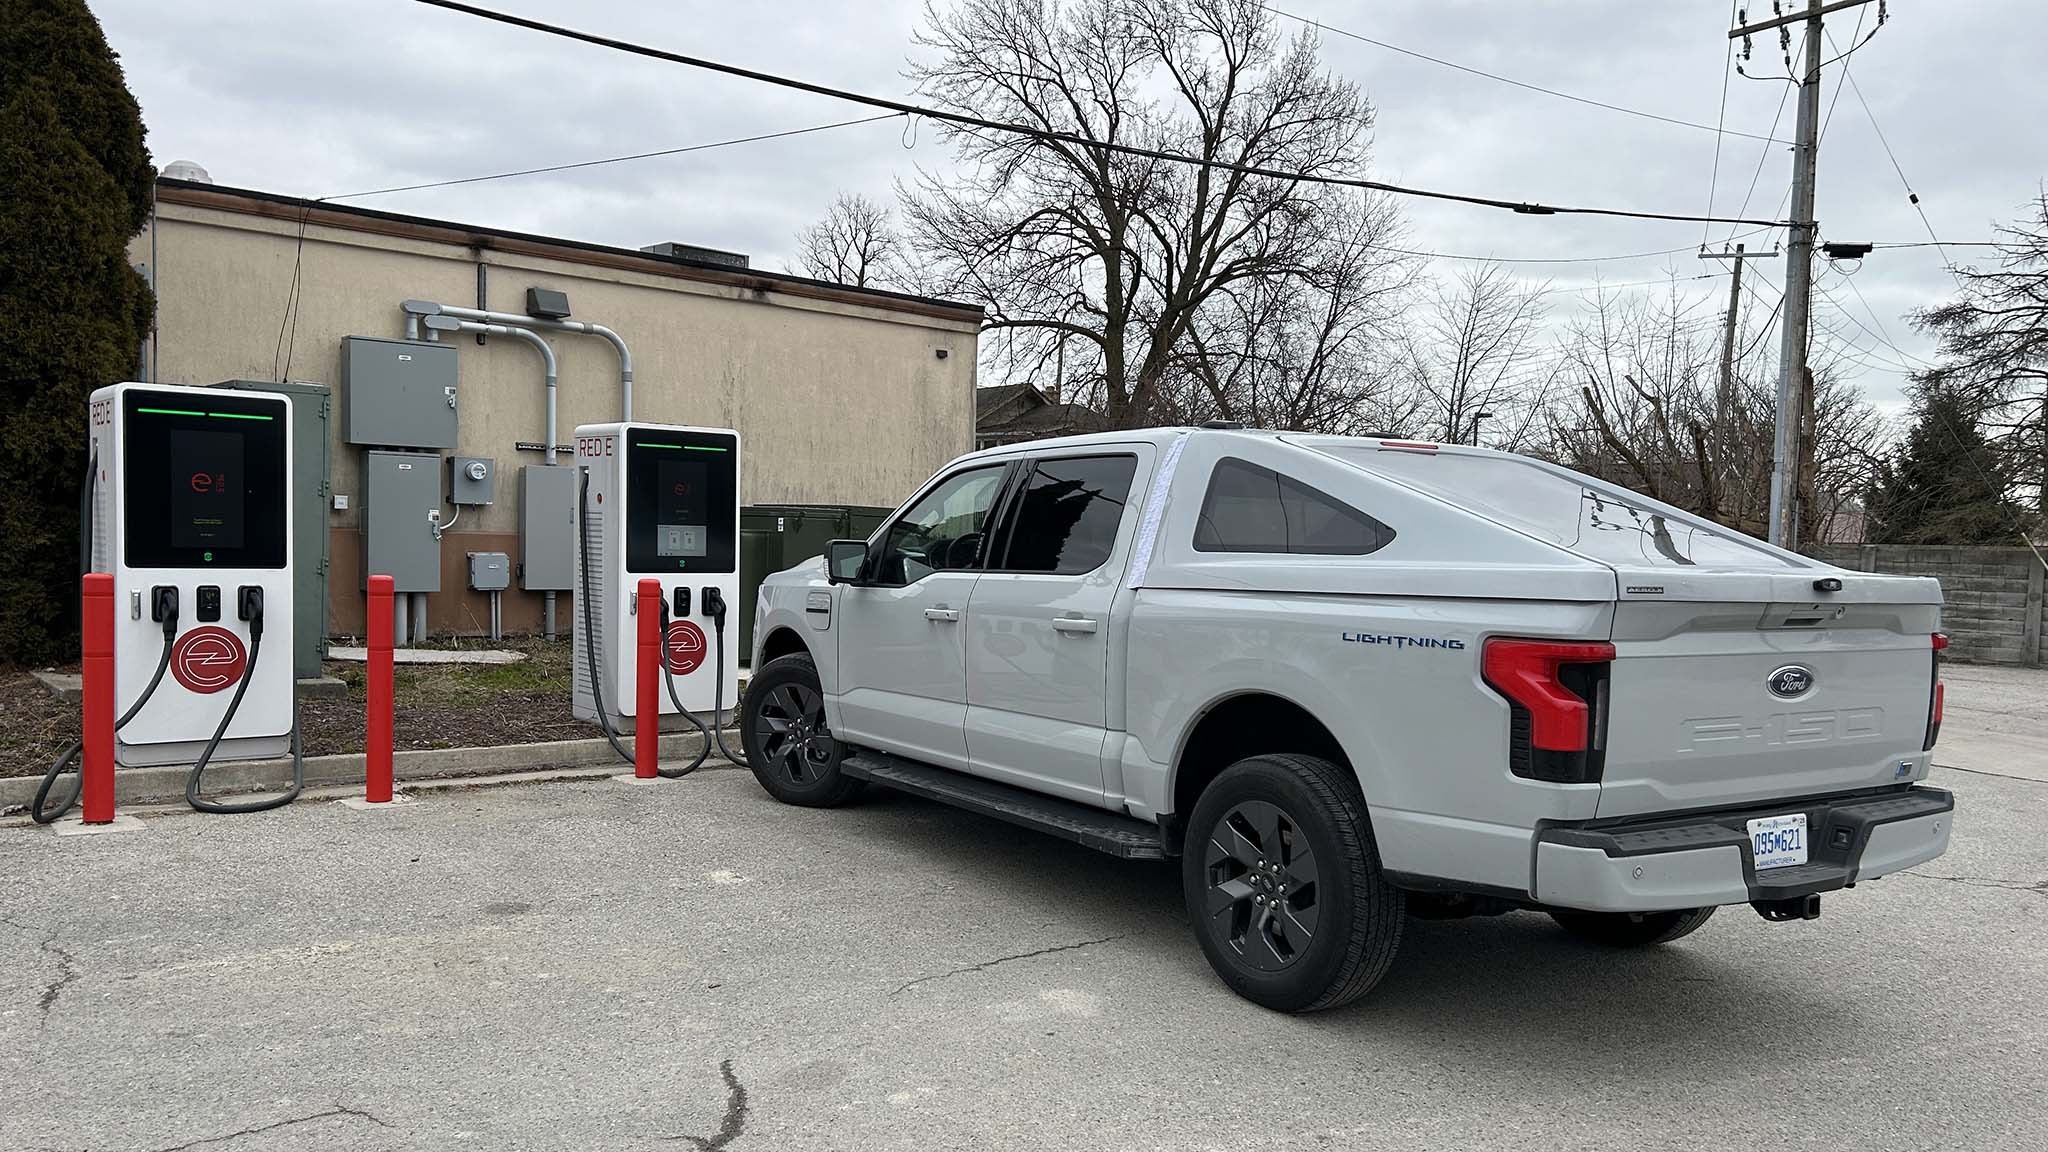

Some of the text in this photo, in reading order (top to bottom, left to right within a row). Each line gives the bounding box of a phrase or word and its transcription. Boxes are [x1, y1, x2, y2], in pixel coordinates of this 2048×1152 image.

[93, 403, 105, 426] RED
[580, 437, 613, 457] RED E
[1342, 632, 1465, 650] LIGHTNING
[1780, 672, 1807, 691] Ford
[1676, 706, 1885, 752] F-150
[1754, 828, 1802, 855] 095M621
